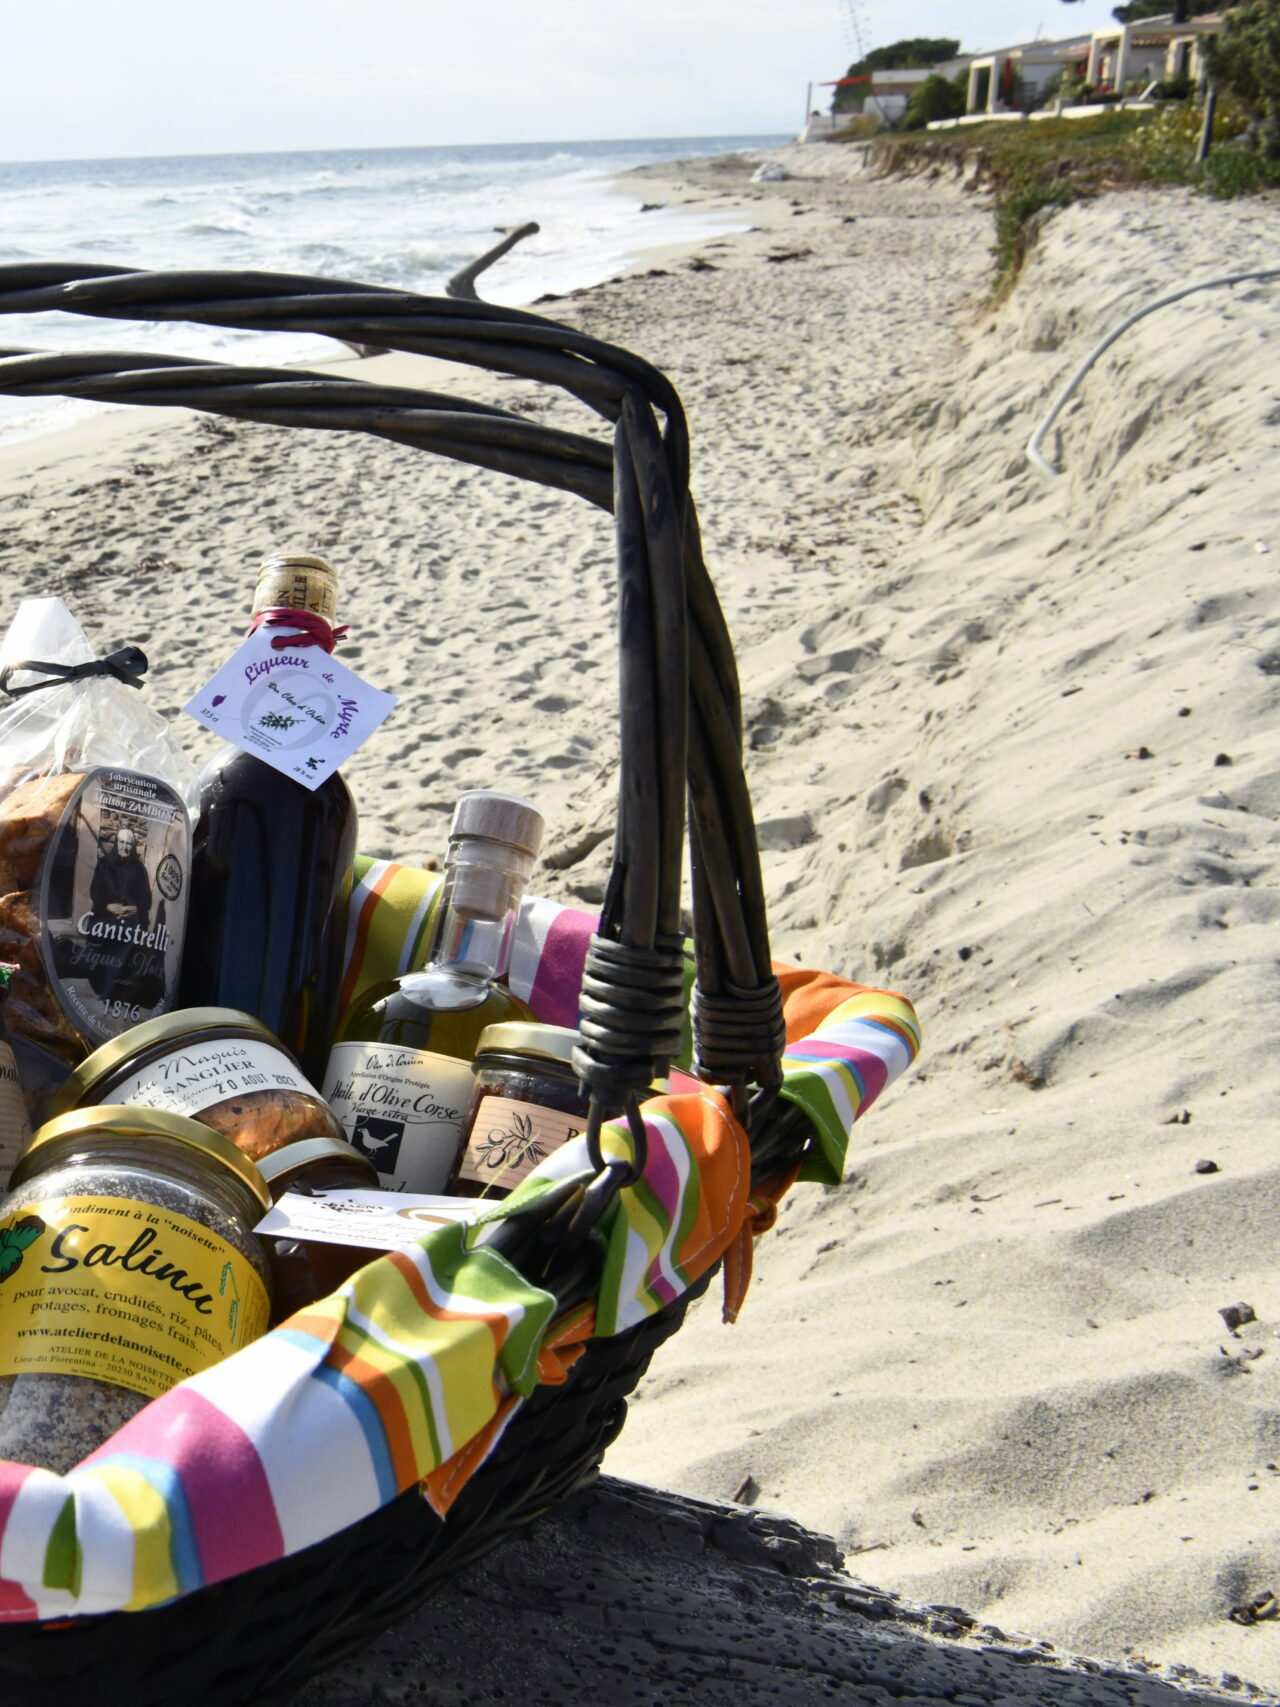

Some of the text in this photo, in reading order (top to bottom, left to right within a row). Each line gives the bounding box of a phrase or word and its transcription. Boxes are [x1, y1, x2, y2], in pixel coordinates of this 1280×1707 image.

[244, 654, 359, 740] Liqueur de Myrte
[113, 782, 157, 799] artisanale
[94, 793, 177, 821] Maison ZAMBONI
[77, 911, 170, 952] Canistrelli
[69, 941, 122, 971] Figues
[66, 985, 89, 1016] Recette
[103, 998, 141, 1022] 1876
[158, 1046, 247, 1080] Maquis
[163, 1059, 256, 1096] SANGLIER
[243, 1073, 269, 1087] AOUT
[350, 1071, 431, 1090] Appellation d'Origine Protégée
[327, 1079, 464, 1120] Huile d'Olive Corse
[349, 1102, 410, 1122] Vierge extra
[133, 1210, 142, 1220] à
[145, 1212, 160, 1225] la
[40, 1223, 213, 1315] Salinu
[13, 1284, 225, 1356] pour avocat, crudités, riz, pâtes,
[30, 1299, 91, 1315] potages,
[95, 1303, 164, 1333] fromages
[13, 1355, 49, 1364] Lieu-dit
[49, 1355, 97, 1368] Fiorentina
[106, 1363, 133, 1378] 20230
[135, 1371, 157, 1387] SAN
[48, 1346, 92, 1357] ATELIER
[94, 1350, 109, 1360] DE
[111, 1355, 126, 1365] LA
